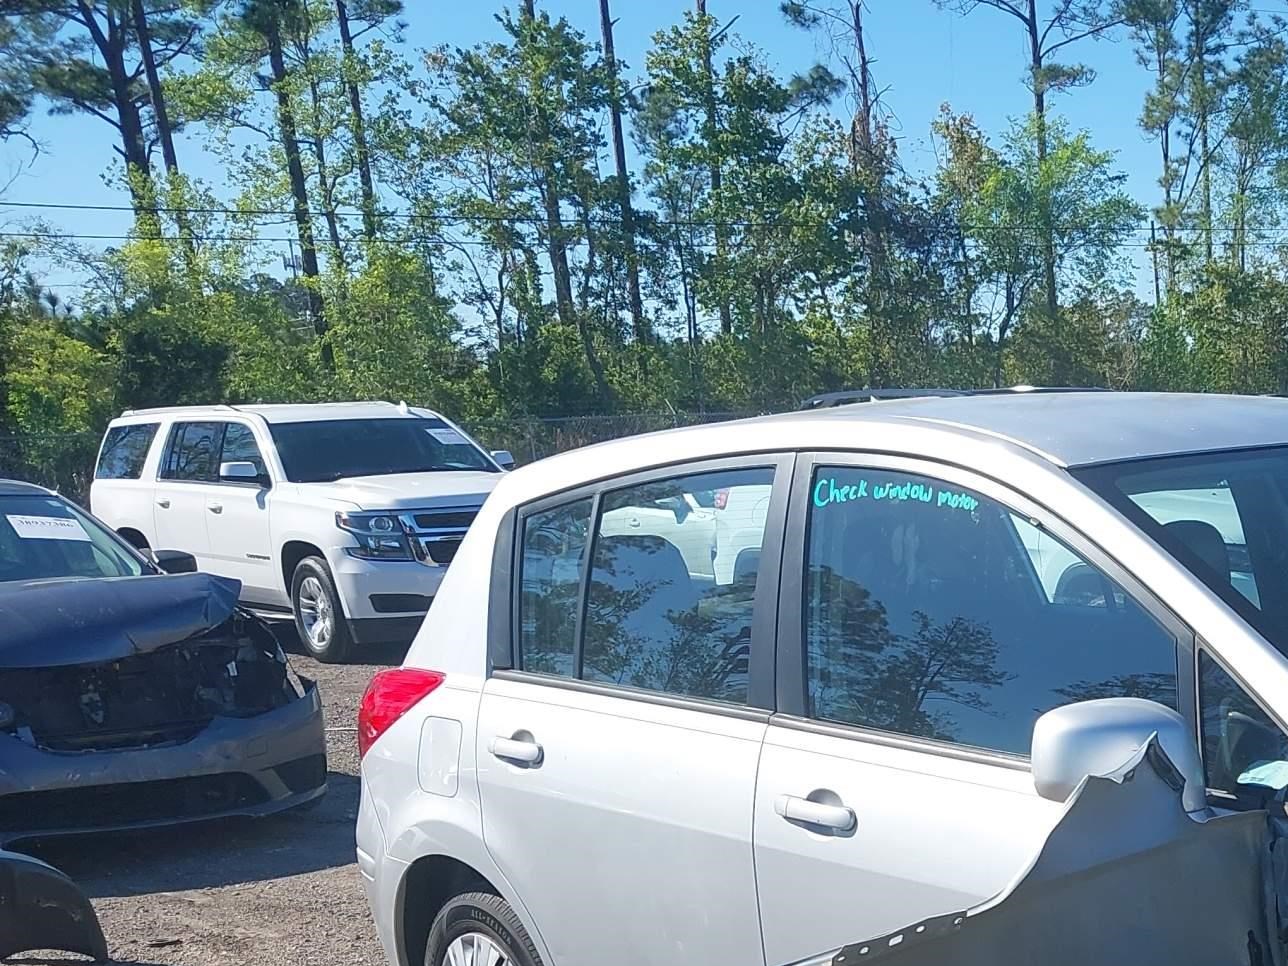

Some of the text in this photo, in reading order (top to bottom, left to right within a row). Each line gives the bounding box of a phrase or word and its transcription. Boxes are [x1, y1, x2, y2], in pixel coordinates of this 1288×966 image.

[814, 478, 978, 511] Check window motor
